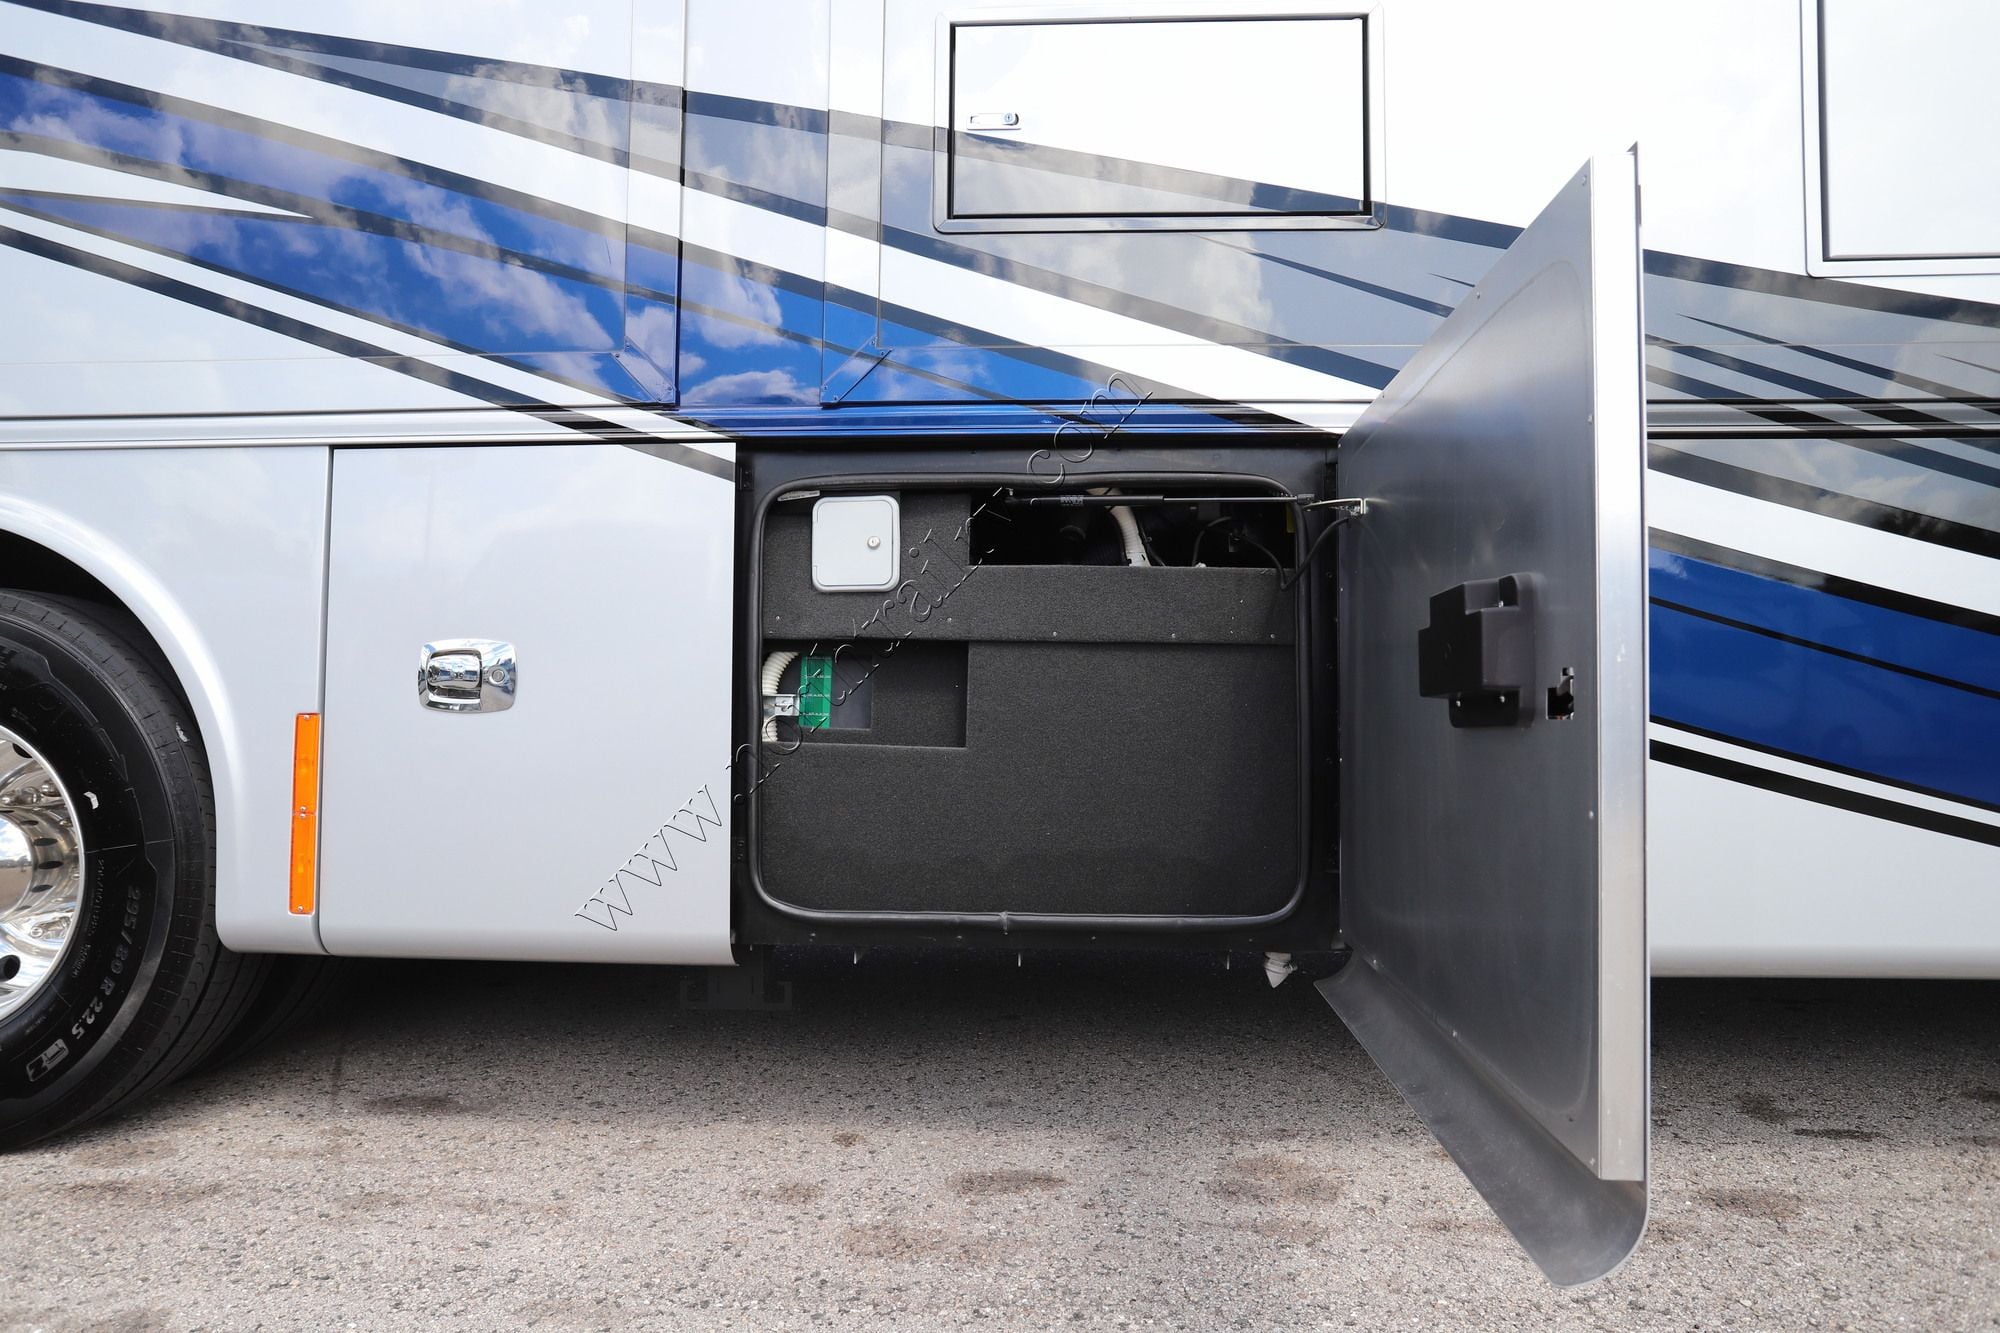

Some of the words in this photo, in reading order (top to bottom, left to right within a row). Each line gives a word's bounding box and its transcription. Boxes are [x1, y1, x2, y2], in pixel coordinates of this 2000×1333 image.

[112, 886, 142, 974] 295/80
[98, 976, 117, 996] R
[71, 995, 103, 1040] 22.5
